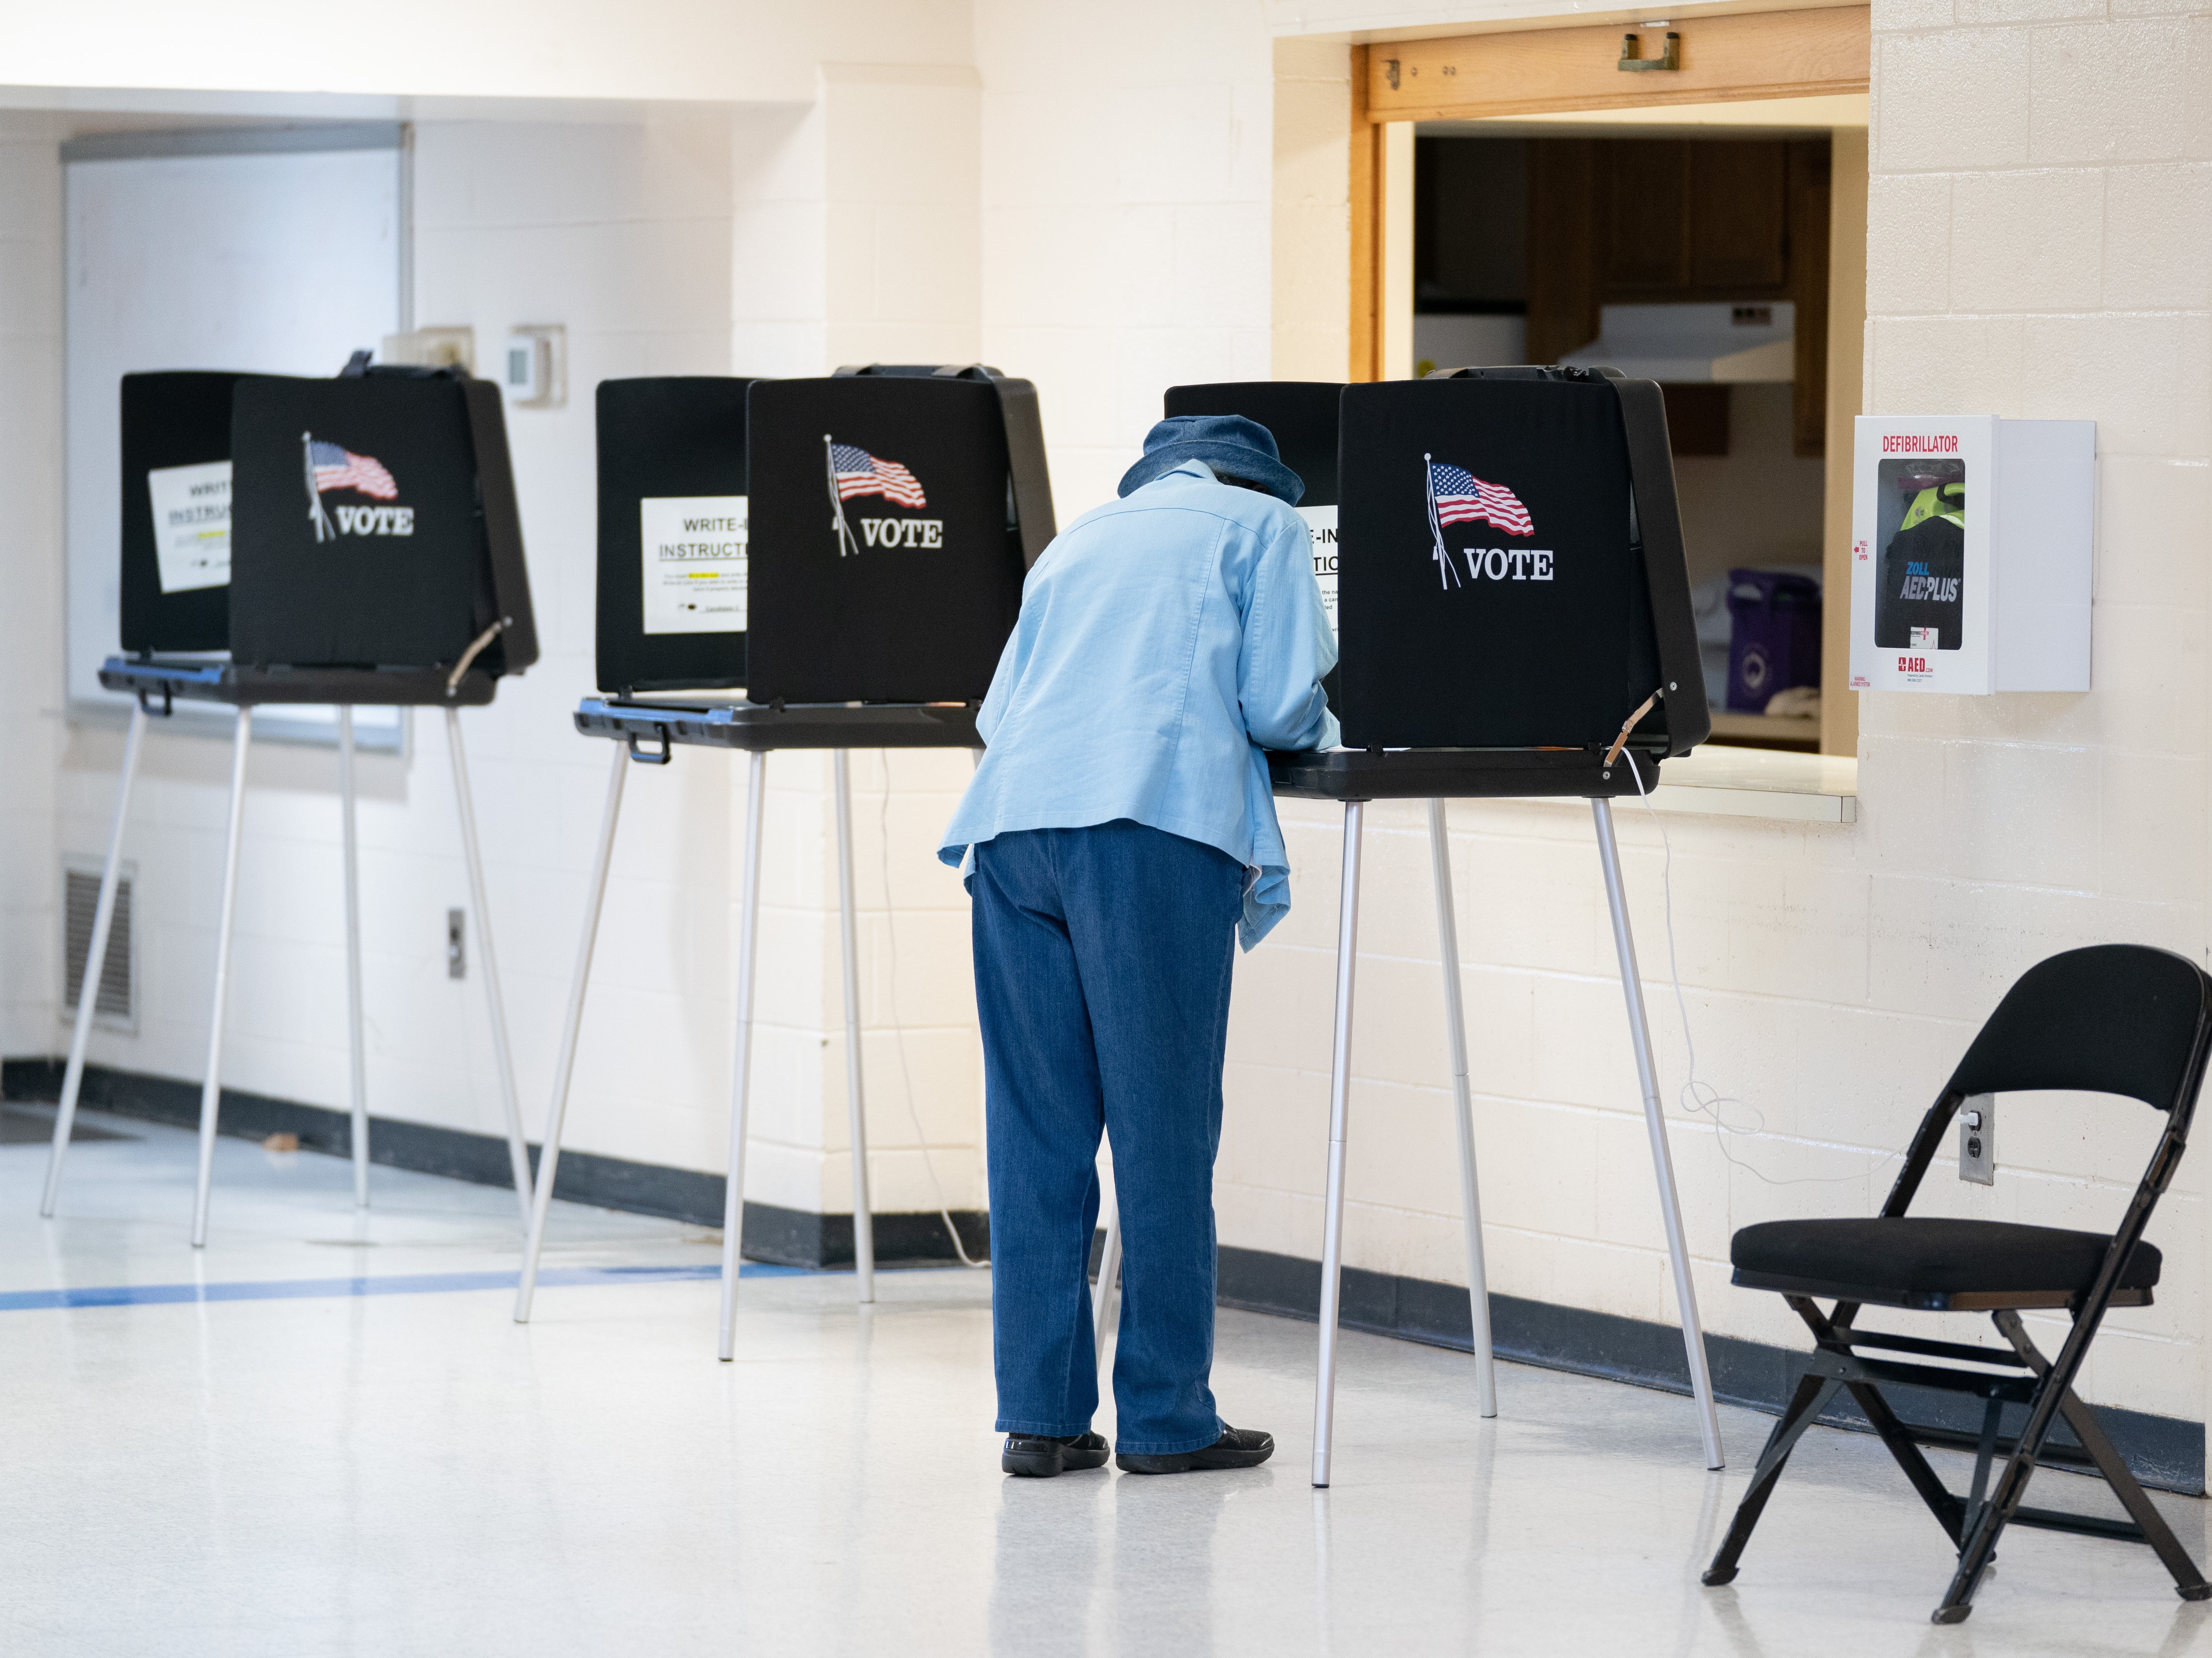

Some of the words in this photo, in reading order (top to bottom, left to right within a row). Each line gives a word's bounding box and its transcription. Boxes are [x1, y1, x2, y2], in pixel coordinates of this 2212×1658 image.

[1883, 435, 1958, 452] DEFIBRILLATOR
[336, 506, 414, 536] VOTE
[860, 518, 943, 548] VOTE
[1464, 548, 1553, 580] VOTE
[1906, 562, 1929, 575] ZOLL
